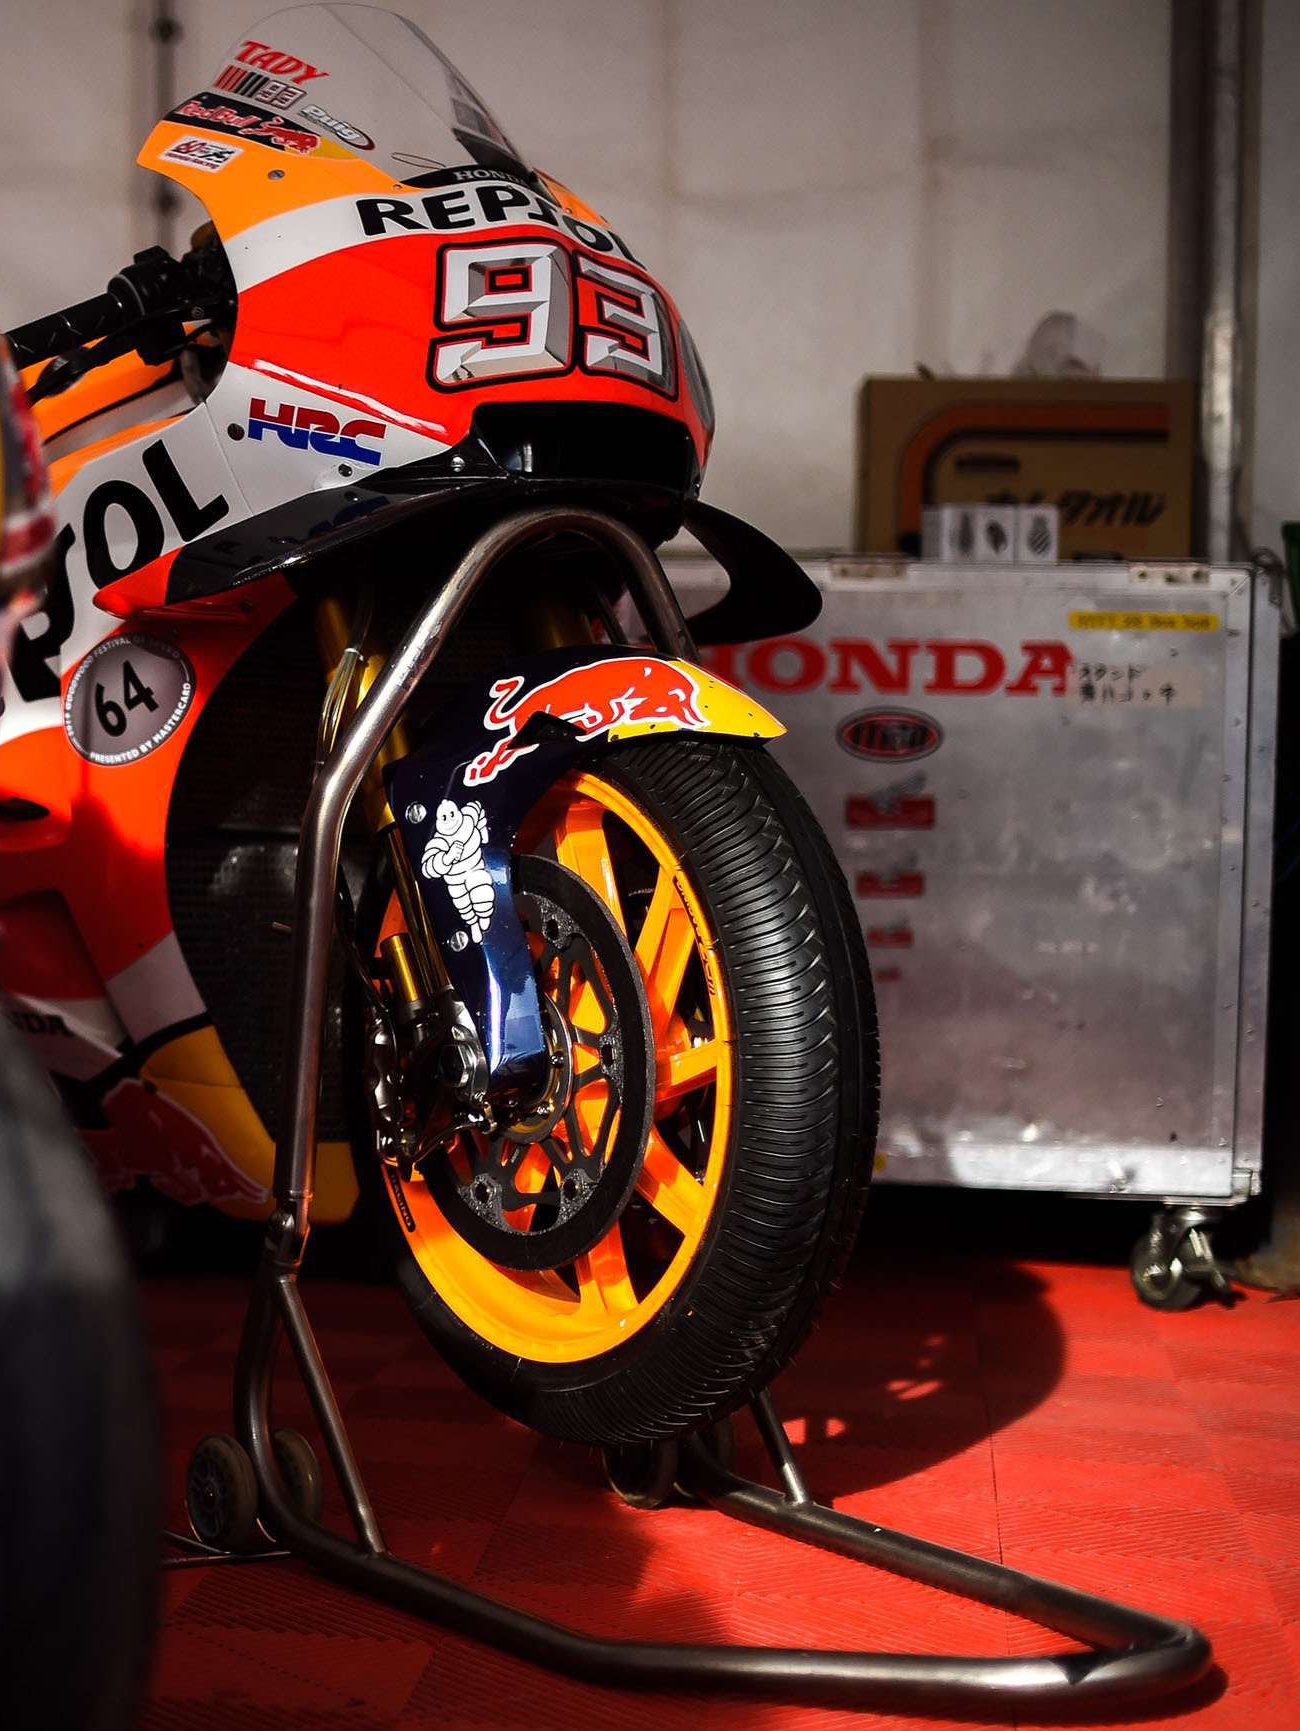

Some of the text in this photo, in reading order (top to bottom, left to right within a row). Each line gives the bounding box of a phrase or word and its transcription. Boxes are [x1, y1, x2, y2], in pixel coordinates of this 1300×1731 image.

[235, 39, 330, 85] TADY
[255, 79, 308, 110] 93
[299, 103, 363, 142] Puig
[426, 236, 681, 405] 93
[247, 397, 386, 466] HRC
[93, 637, 131, 658] FESTIVAL
[89, 748, 140, 764] PRESENTED
[151, 682, 191, 744] MASTERCARD
[94, 660, 159, 738] 64
